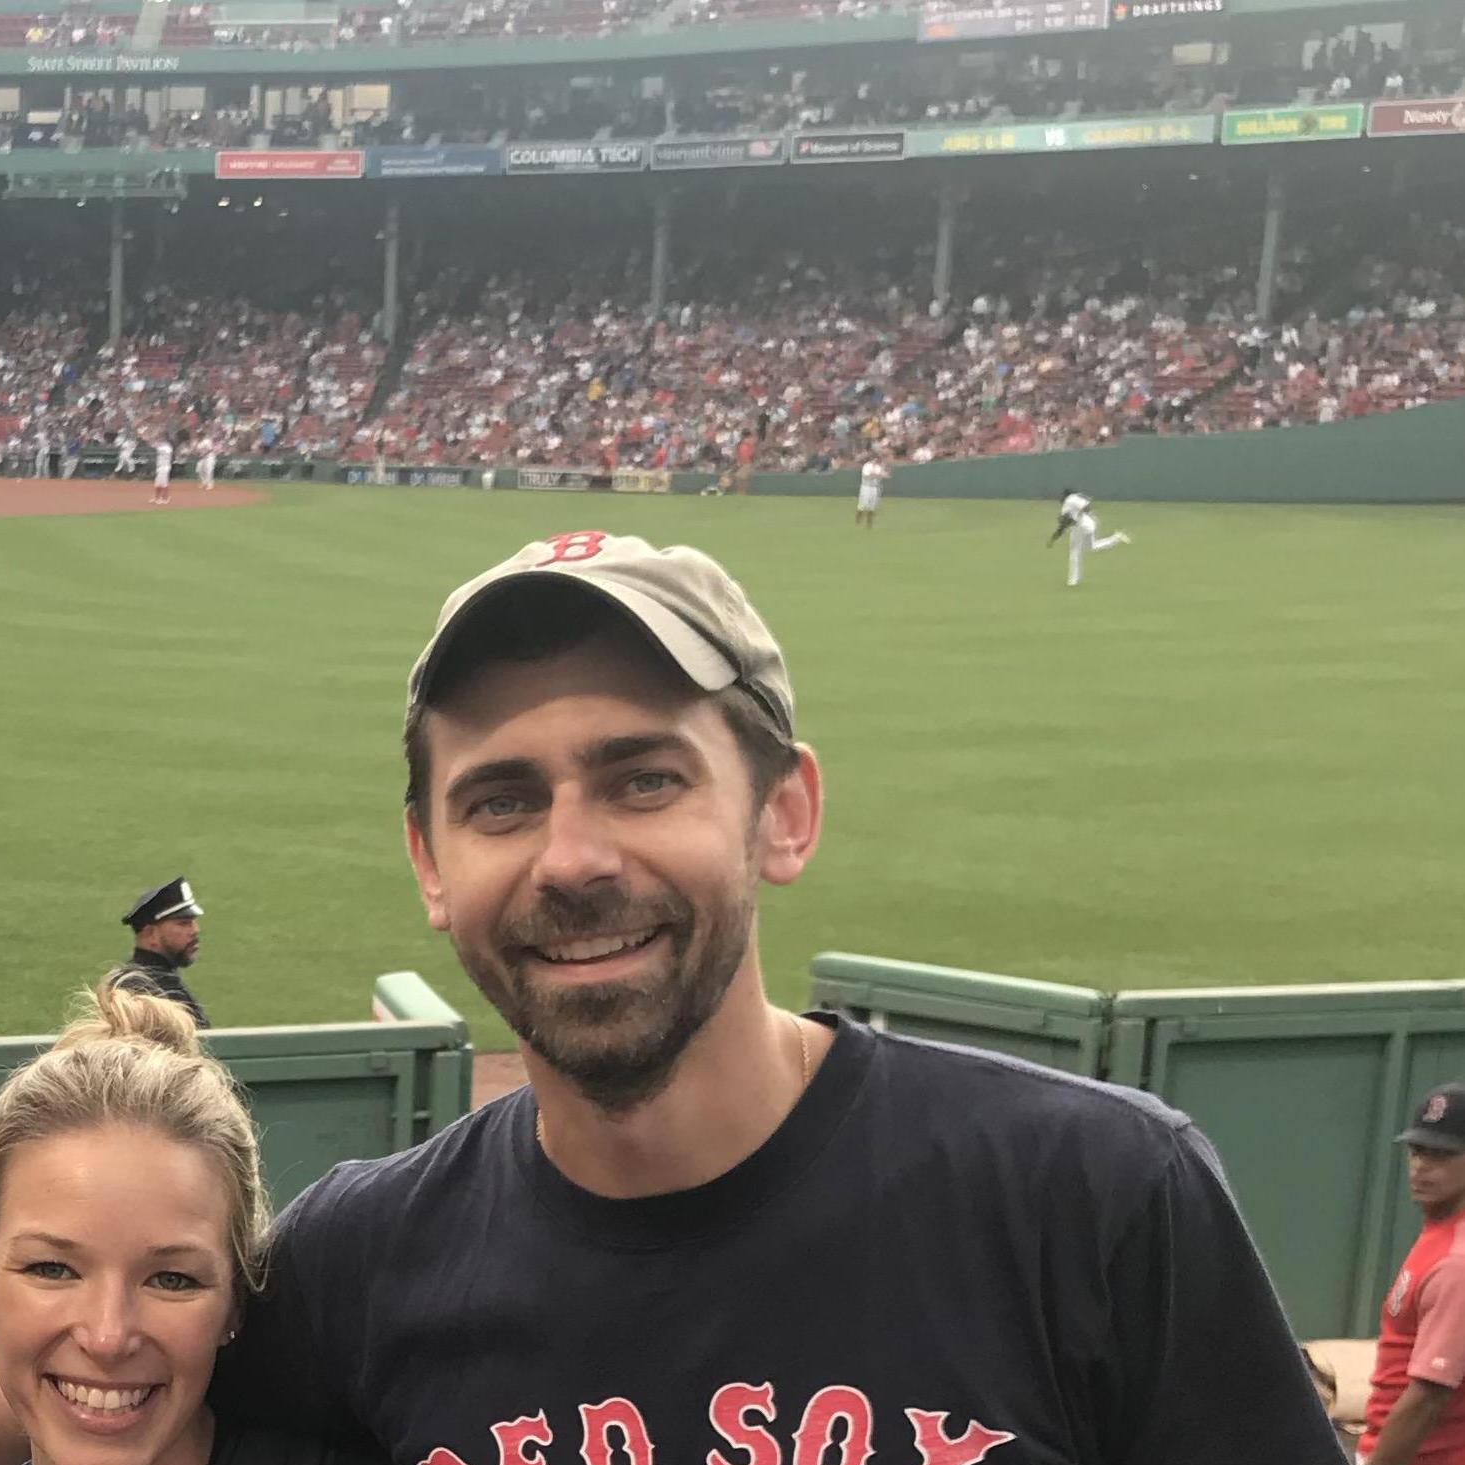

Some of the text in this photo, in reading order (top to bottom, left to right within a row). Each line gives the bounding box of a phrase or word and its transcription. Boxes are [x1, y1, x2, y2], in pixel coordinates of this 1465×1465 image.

[116, 55, 180, 72] PAVILION
[1402, 109, 1452, 126] Ninety
[510, 148, 594, 164] COLUMBIA
[599, 148, 638, 163] TECH
[536, 528, 606, 568] B
